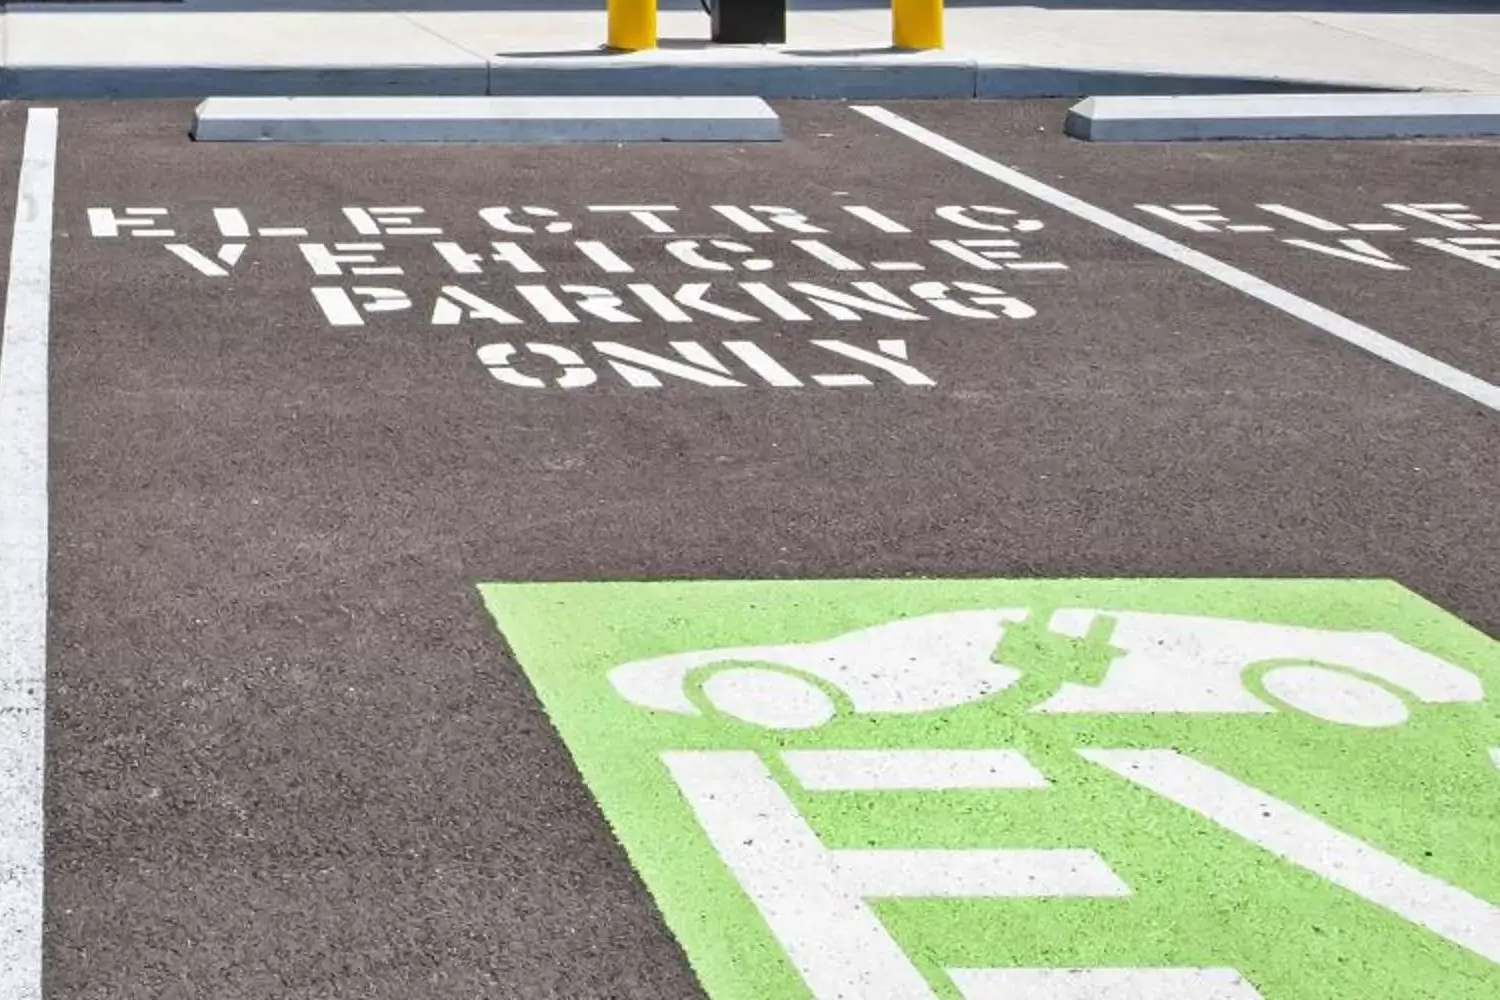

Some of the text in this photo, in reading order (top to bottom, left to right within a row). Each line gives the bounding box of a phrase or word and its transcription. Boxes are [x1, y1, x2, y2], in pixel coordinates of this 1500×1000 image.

[87, 206, 1045, 237] ELECTRIC
[164, 240, 1068, 276] VEHICLE
[311, 281, 1037, 326] PARKING
[476, 340, 938, 389] ONLY
